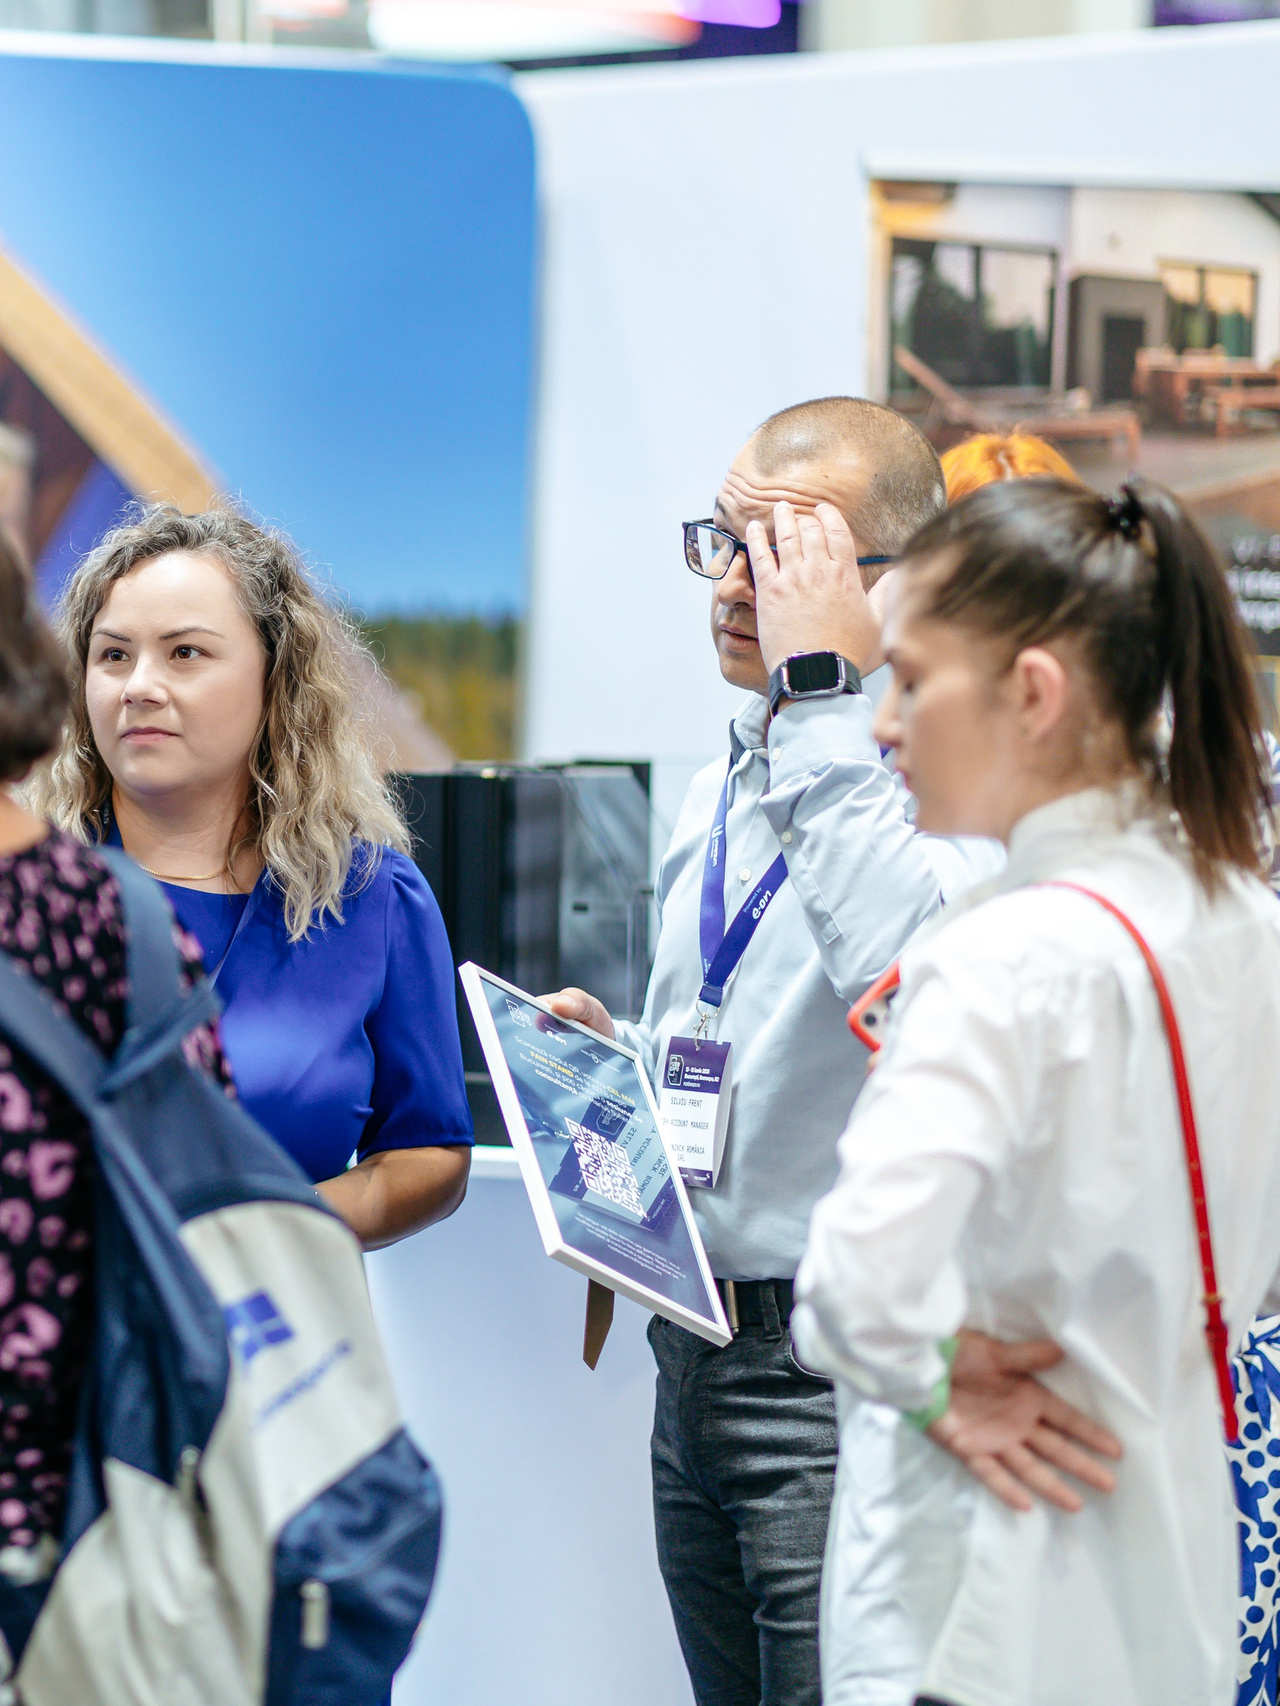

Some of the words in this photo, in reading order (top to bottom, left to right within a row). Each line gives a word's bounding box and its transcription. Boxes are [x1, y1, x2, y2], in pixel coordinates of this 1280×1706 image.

[671, 1097, 687, 1106] SILVIU
[671, 1119, 688, 1127] ACCOUNT
[690, 1121, 709, 1130] MANAGER
